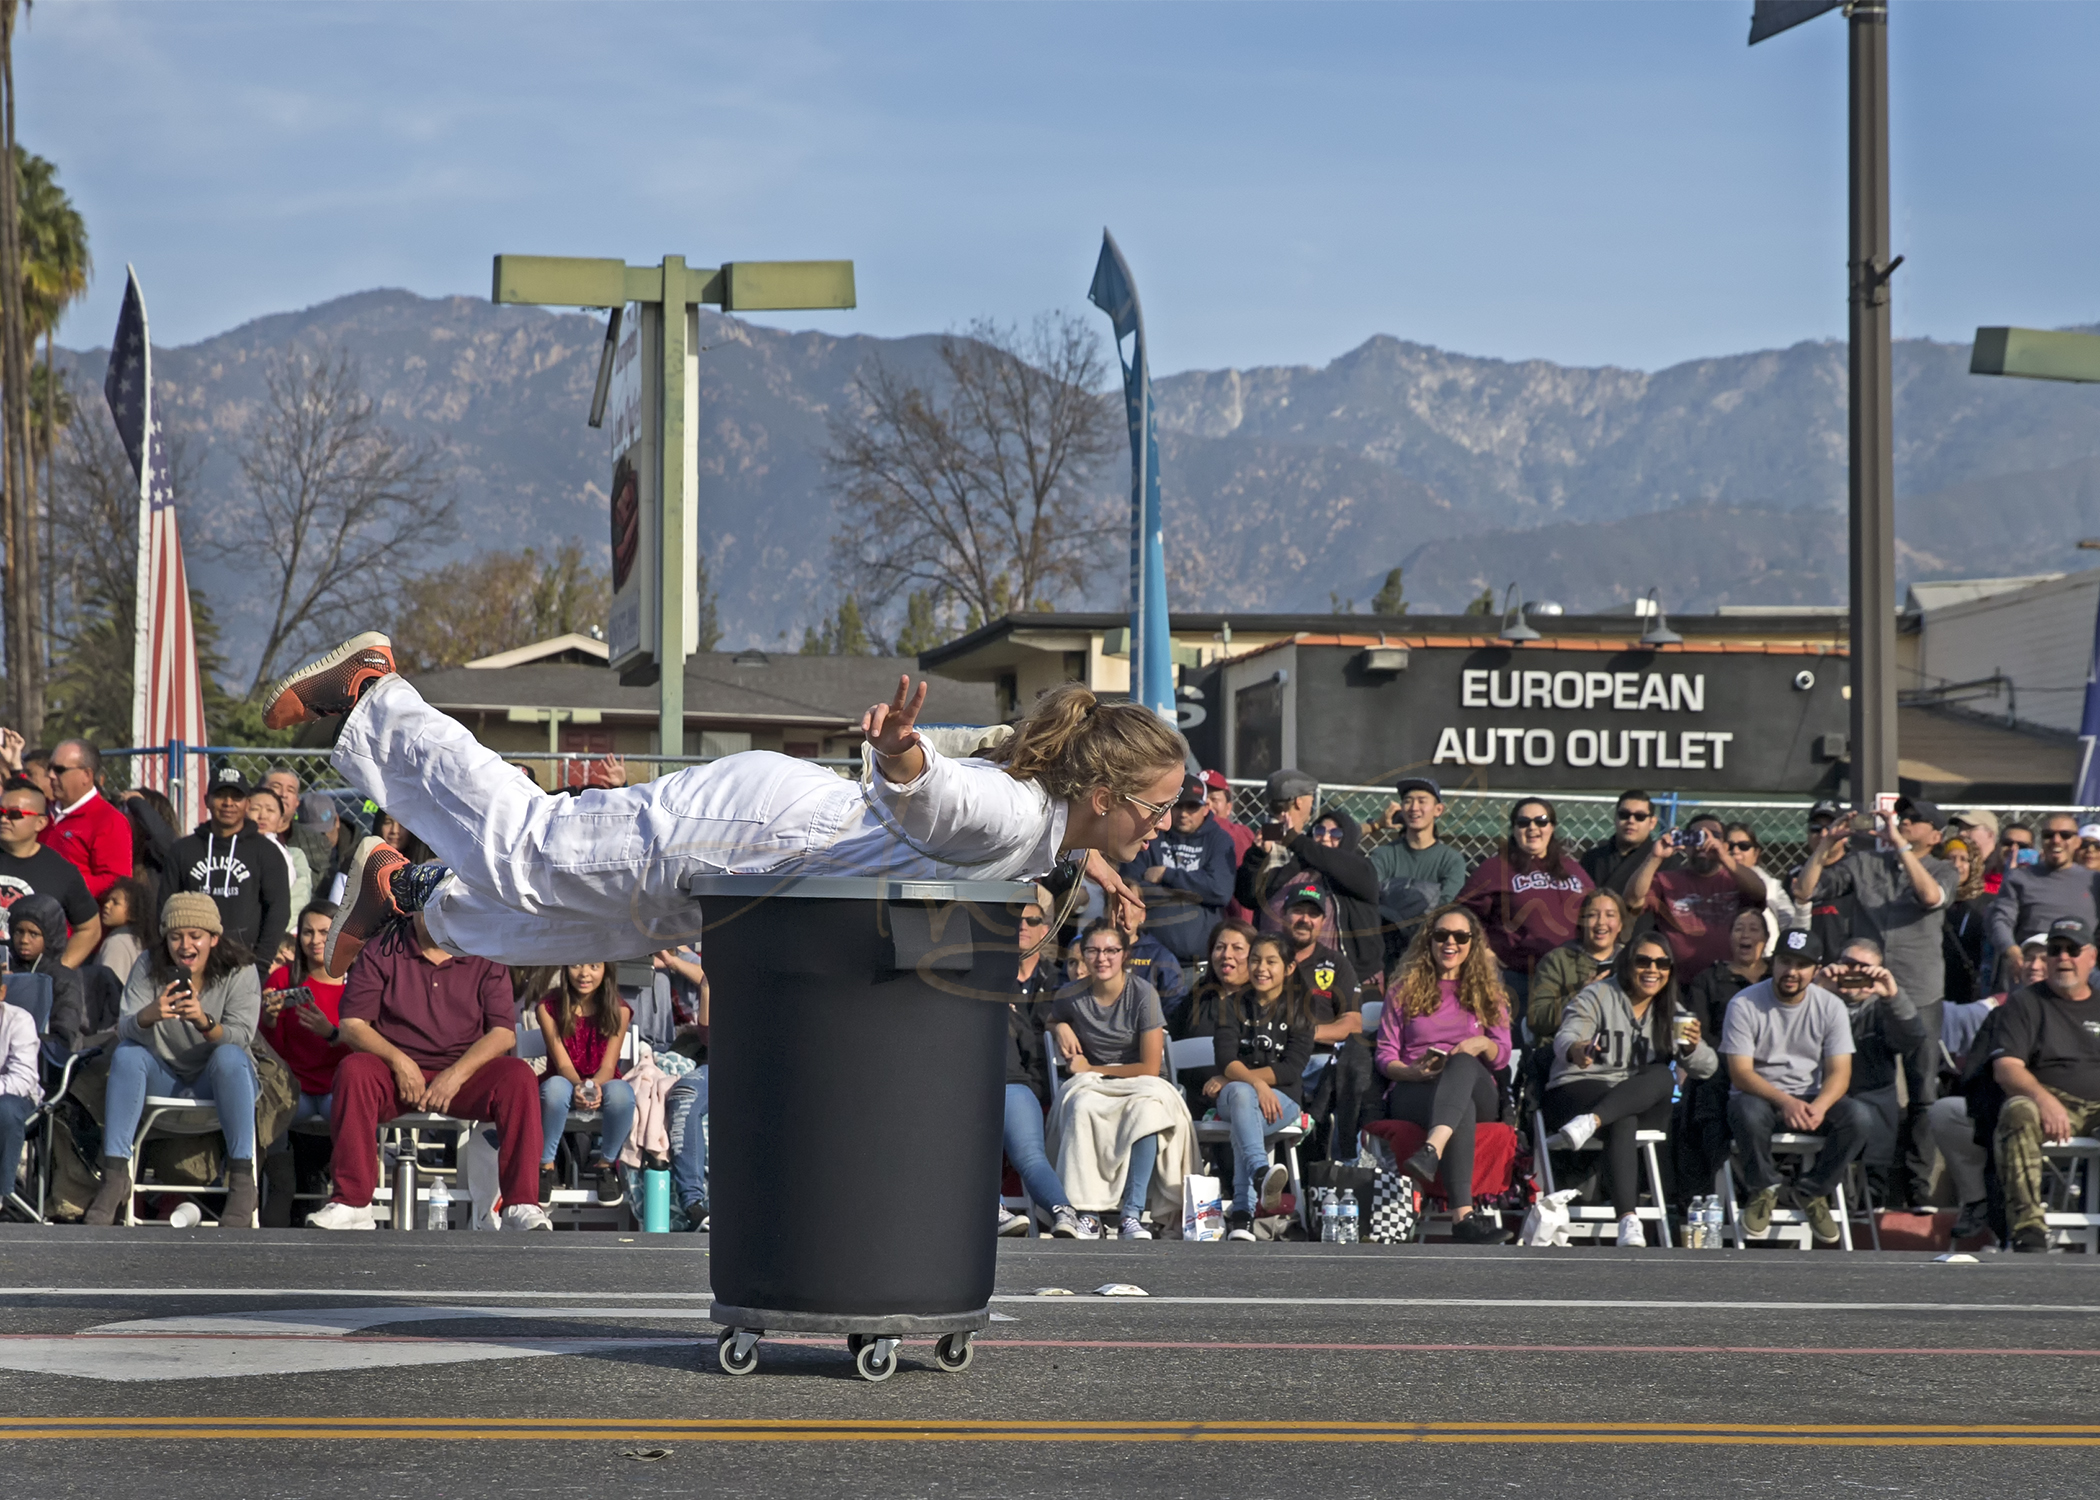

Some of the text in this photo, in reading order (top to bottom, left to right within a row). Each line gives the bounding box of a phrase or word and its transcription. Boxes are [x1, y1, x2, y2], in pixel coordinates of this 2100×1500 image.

[1462, 669, 1705, 711] EUROPEAN
[1432, 727, 1733, 769] AUTO OUTLET
